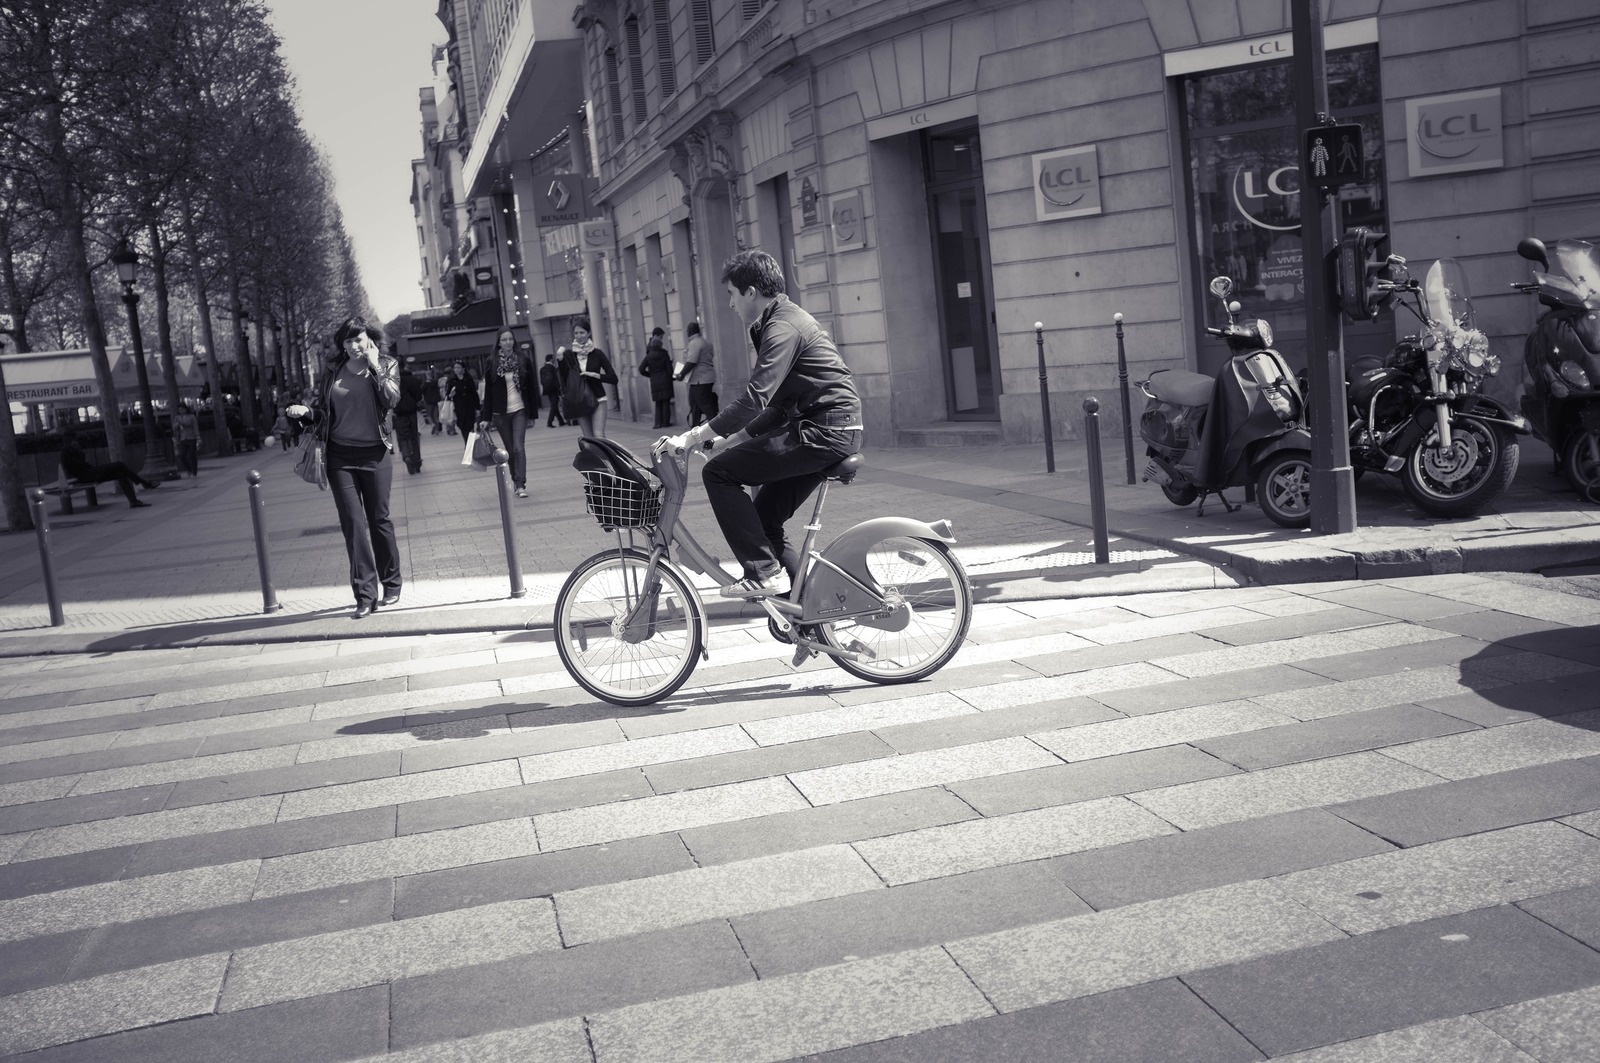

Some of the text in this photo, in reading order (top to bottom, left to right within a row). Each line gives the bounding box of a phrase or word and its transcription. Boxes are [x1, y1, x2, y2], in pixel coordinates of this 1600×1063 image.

[1249, 41, 1287, 56] LCL
[910, 112, 930, 125] LCL
[1424, 114, 1491, 139] LCL
[1044, 166, 1091, 188] LCL
[1244, 166, 1300, 198] LC
[541, 212, 579, 222] RENAULT
[585, 228, 610, 239] LCL
[1277, 254, 1303, 264] VIVEZ
[7, 385, 92, 400] RESTAURANT BAR
